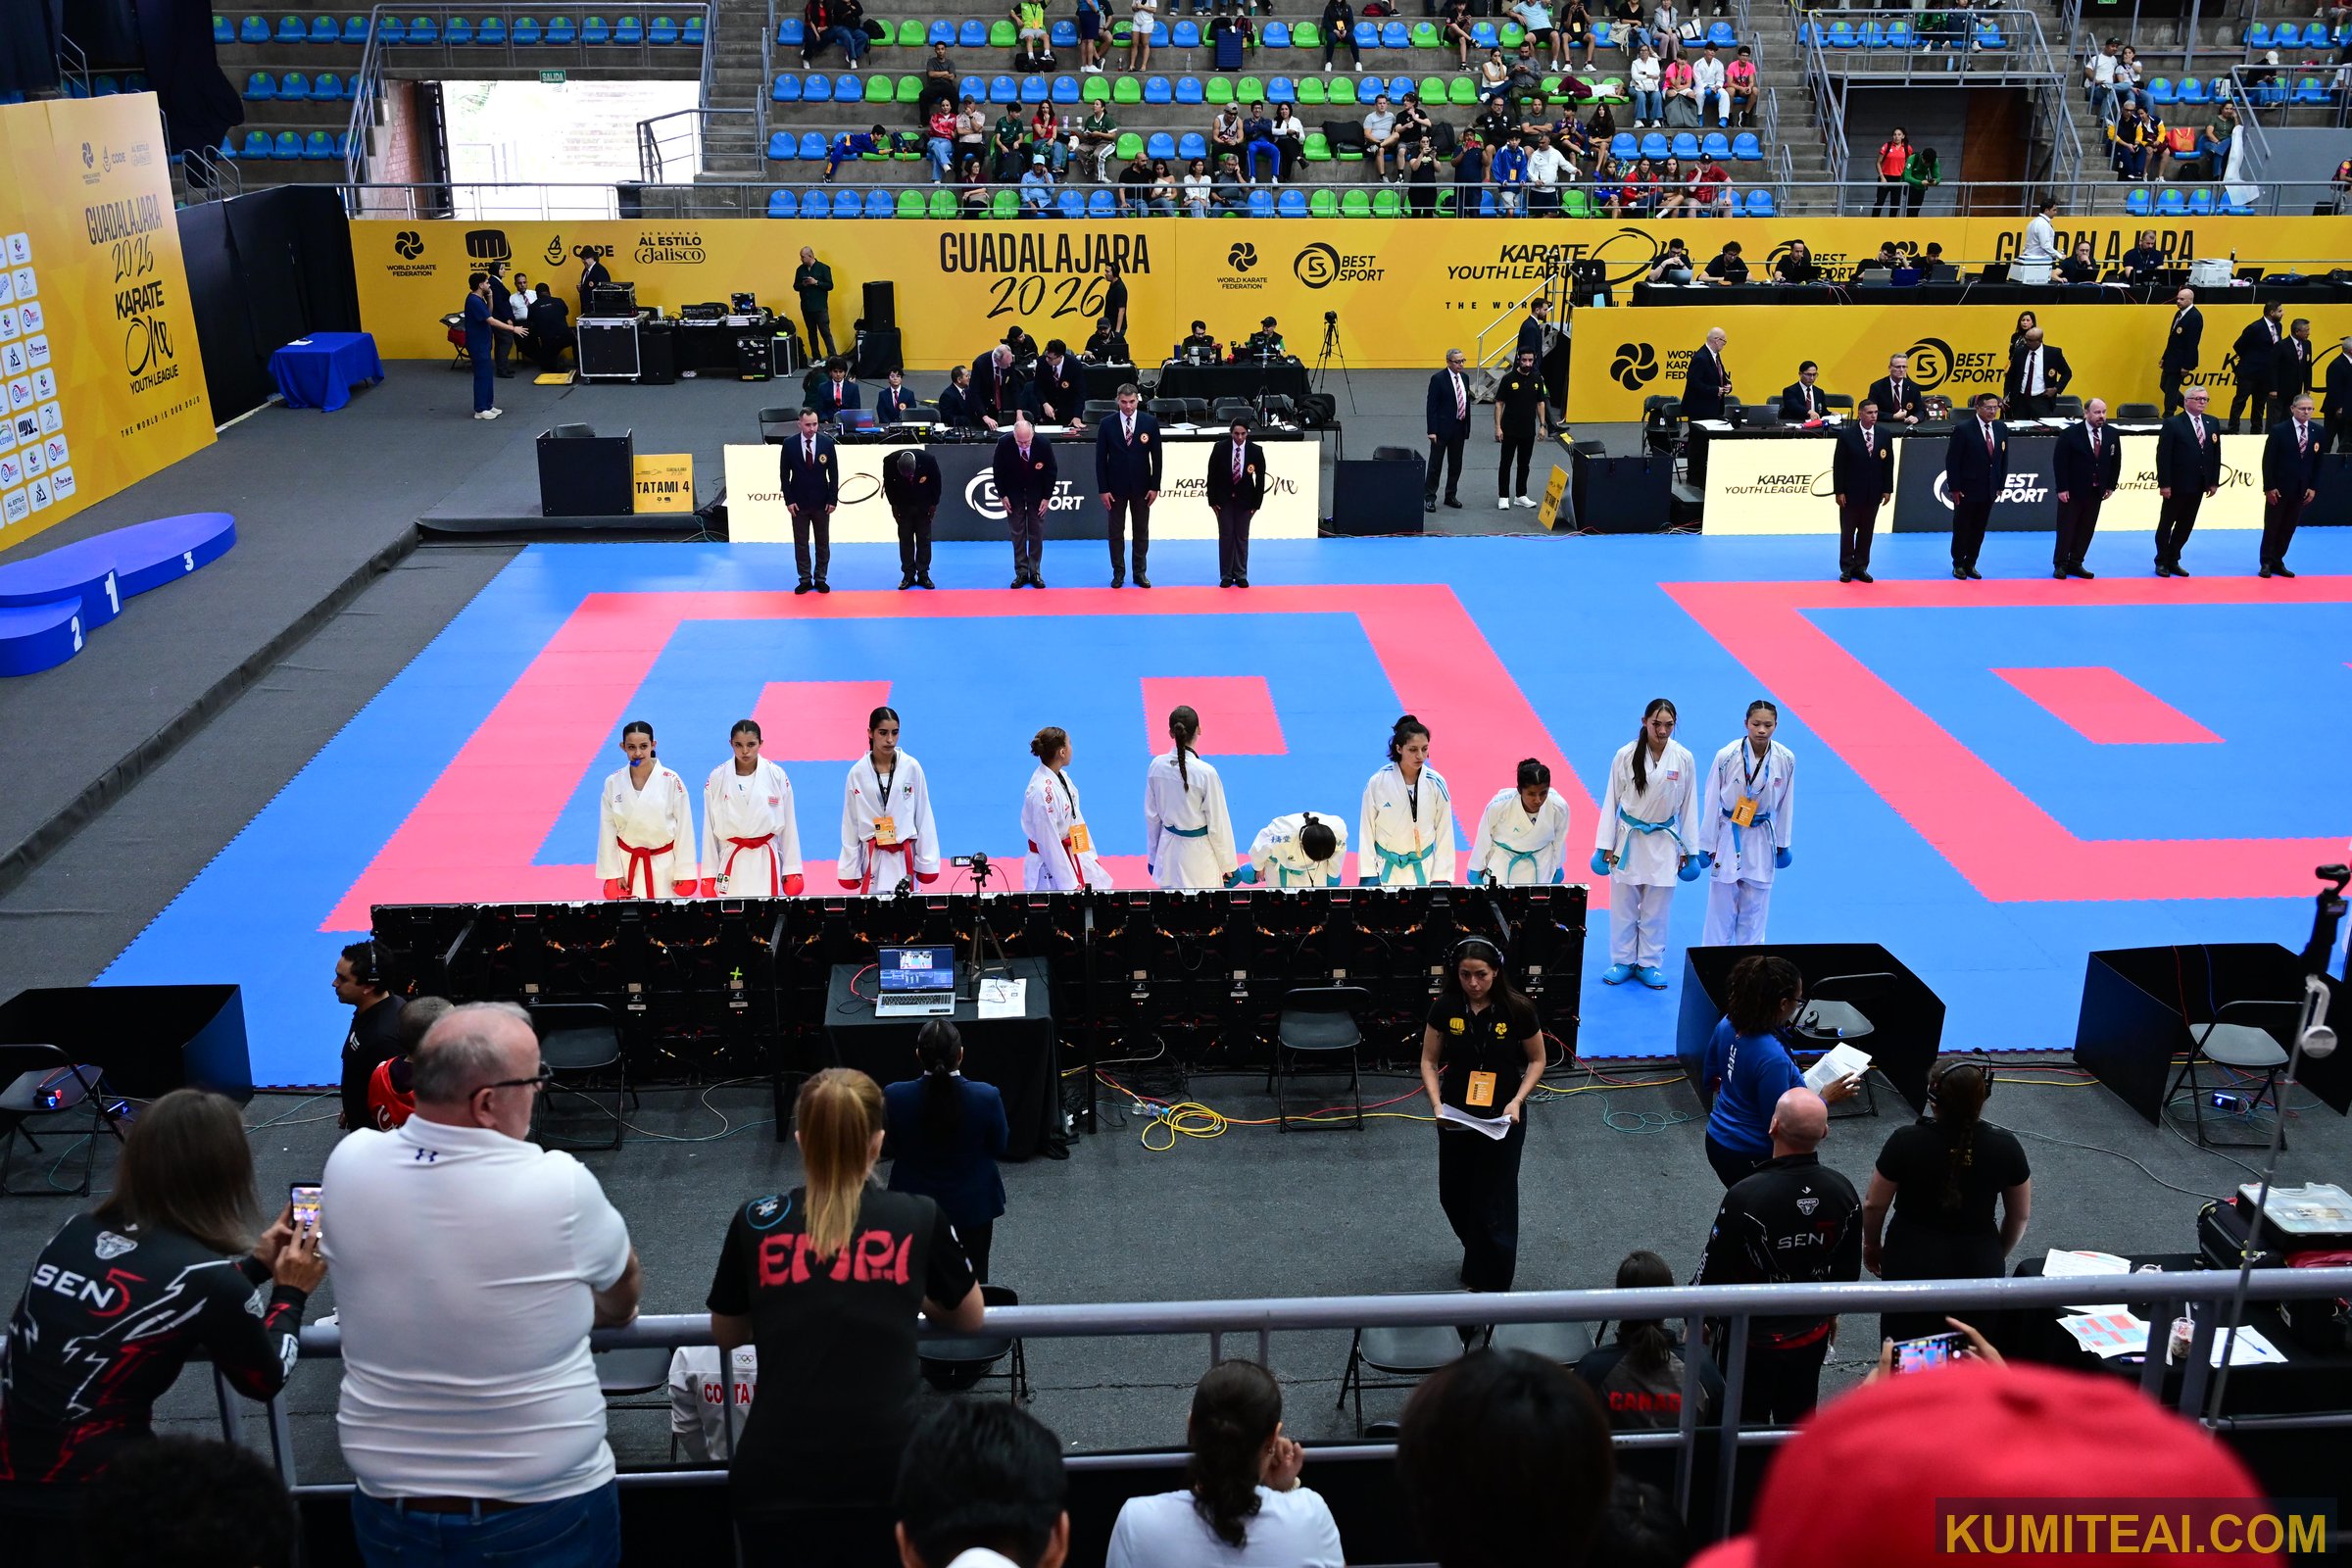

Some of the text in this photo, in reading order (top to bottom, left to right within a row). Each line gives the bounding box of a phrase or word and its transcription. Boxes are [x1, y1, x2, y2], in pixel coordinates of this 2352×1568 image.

[542, 73, 564, 81] SALIDA
[85, 194, 163, 245] GUADALAJARA
[639, 236, 702, 246] AL ESTILO
[573, 245, 614, 257] CDE
[642, 248, 701, 264] Jalisco
[940, 232, 1151, 273] GUADALAJARA
[1499, 244, 1590, 263] KARATE
[112, 235, 154, 283] 2026
[1342, 256, 1376, 268] BEST
[1813, 254, 1847, 265] BEST
[1339, 270, 1385, 281] SPORT
[1447, 266, 1574, 279] YOUTH LEAGU
[1820, 268, 1855, 279] PORT
[115, 280, 165, 319] KARATE
[987, 275, 1105, 318] 2026
[125, 316, 173, 376] One
[1667, 350, 1696, 359] WOR
[1955, 353, 1996, 367] BEST
[1666, 361, 1690, 369] KAR
[130, 365, 179, 395] YOUTH LEAGUE
[1951, 369, 2005, 382] SPORT
[2181, 373, 2230, 386] OUTH
[122, 396, 200, 437] THE WORLD IS OUR DOJO
[636, 481, 690, 493] TATAMI 4
[1176, 478, 1207, 488] KAR
[1757, 474, 1812, 485] KARATE
[2004, 473, 2038, 488] EST
[1053, 480, 1072, 495] ST
[1158, 489, 1181, 498] UTH
[1048, 496, 1085, 511] ORT
[183, 551, 195, 572] 3
[104, 570, 121, 614] 1
[71, 615, 83, 653] 2
[704, 1382, 751, 1403] COTA
[1609, 1392, 1683, 1411] CANAD
